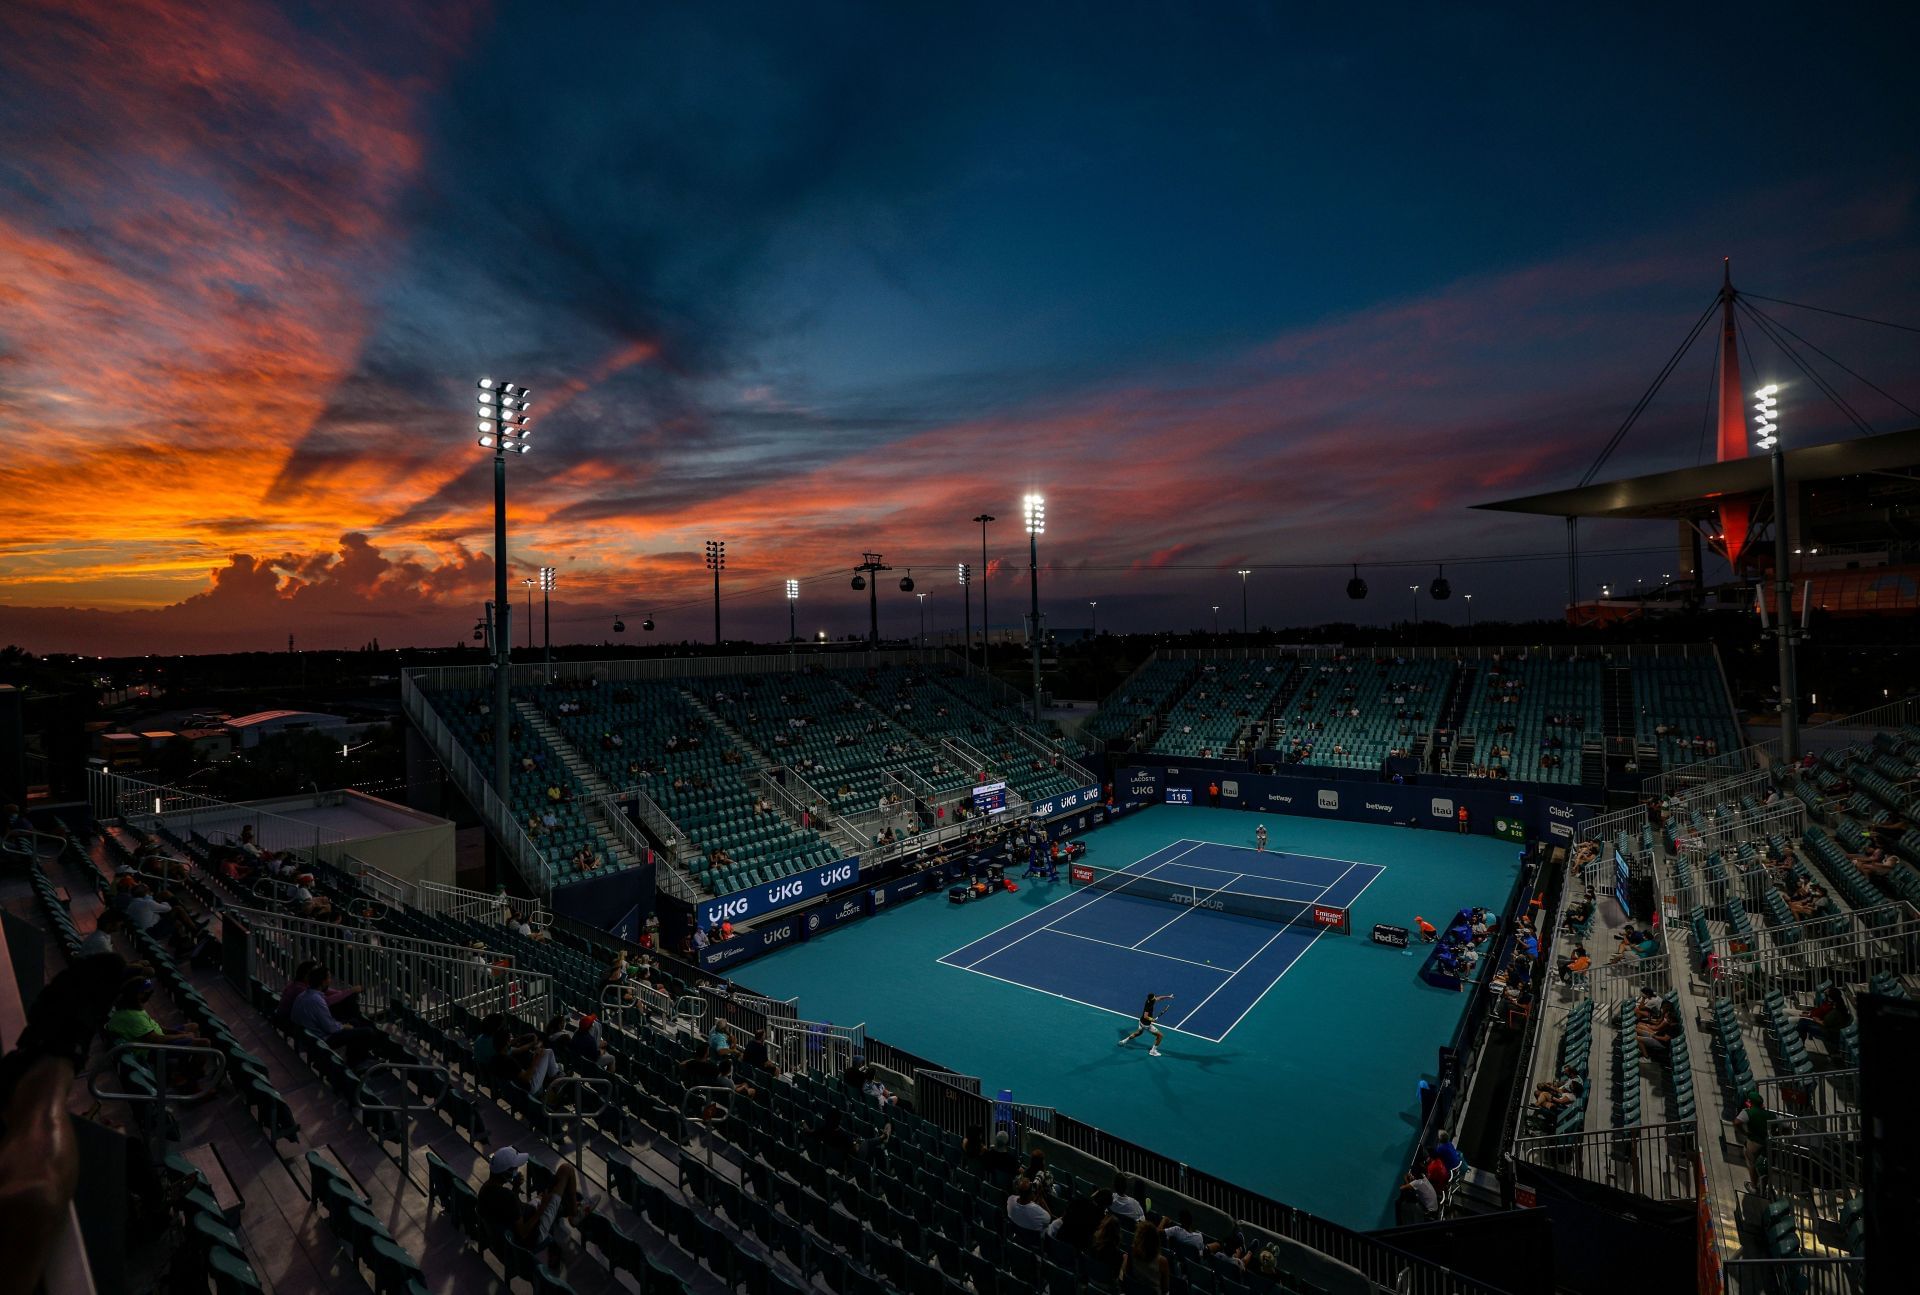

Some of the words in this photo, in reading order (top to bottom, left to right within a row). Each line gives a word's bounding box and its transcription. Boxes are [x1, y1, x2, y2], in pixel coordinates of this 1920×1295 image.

[1268, 793, 1292, 804] betway
[1319, 797, 1337, 807] Itaú
[1365, 802, 1393, 813] betway
[1433, 806, 1451, 815] Itaú
[1549, 806, 1571, 819] Claro
[1195, 896, 1224, 911] TOUR
